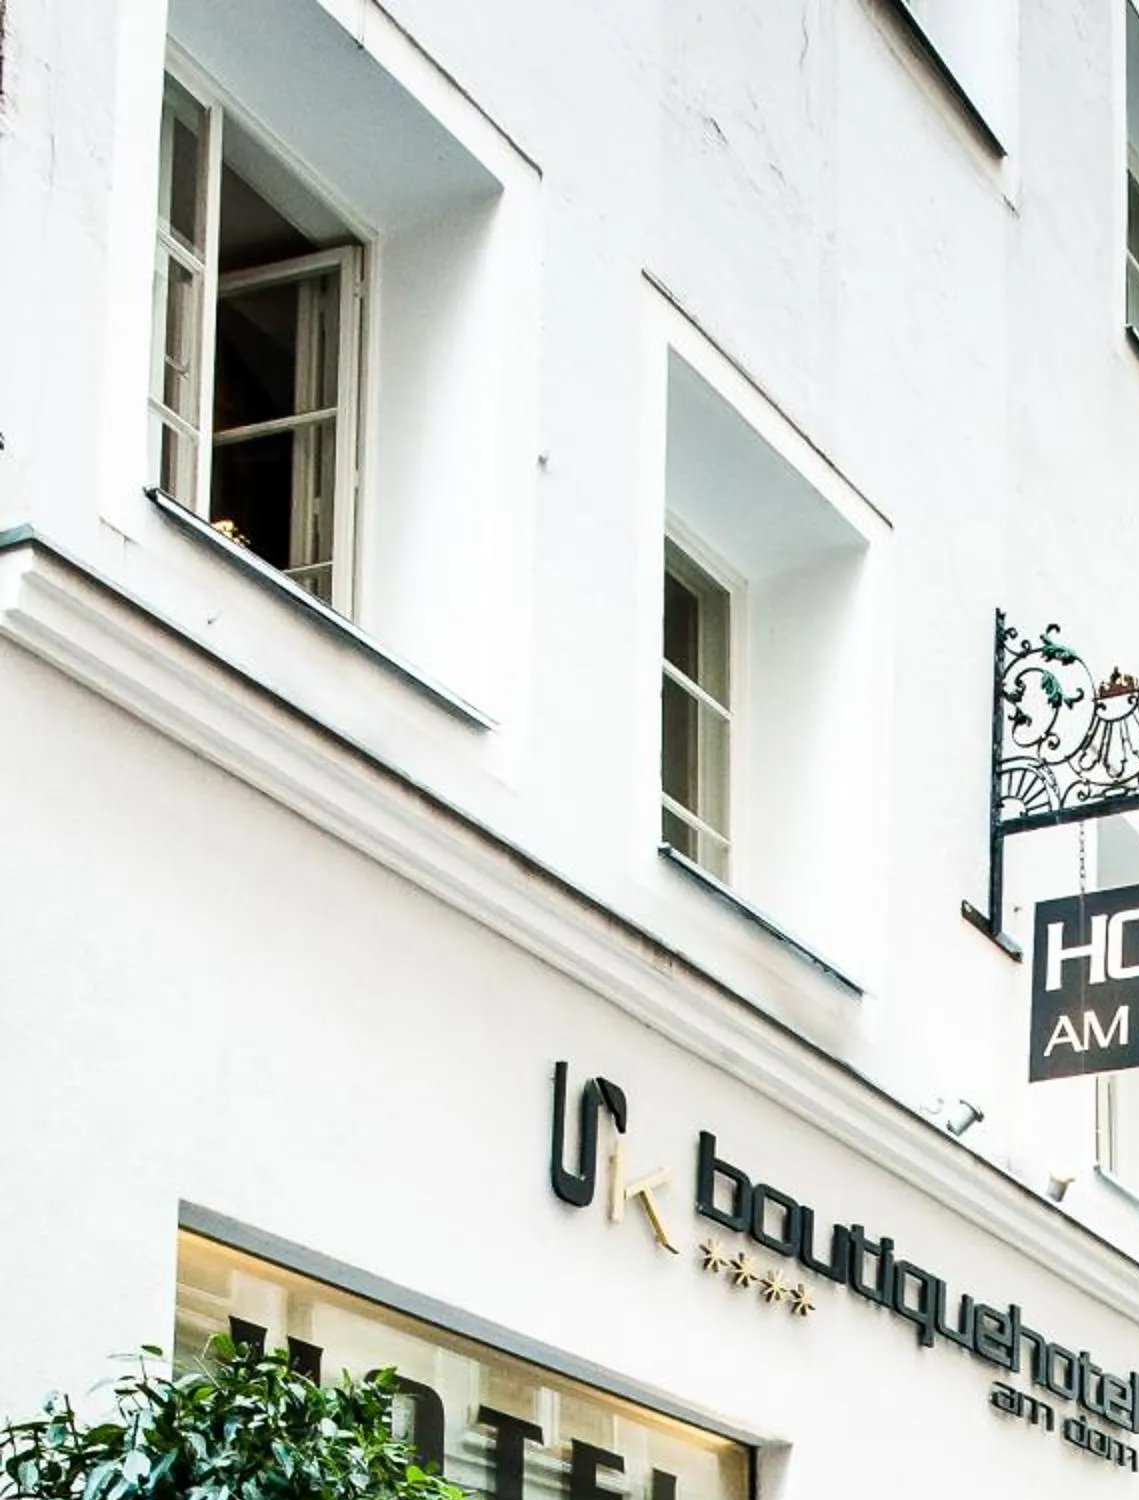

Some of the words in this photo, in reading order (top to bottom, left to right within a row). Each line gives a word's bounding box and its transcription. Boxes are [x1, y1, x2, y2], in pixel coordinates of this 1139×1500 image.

[1043, 1005, 1130, 1057] AM
[989, 1380, 1055, 1433] am
[1063, 1415, 1139, 1472] dom
